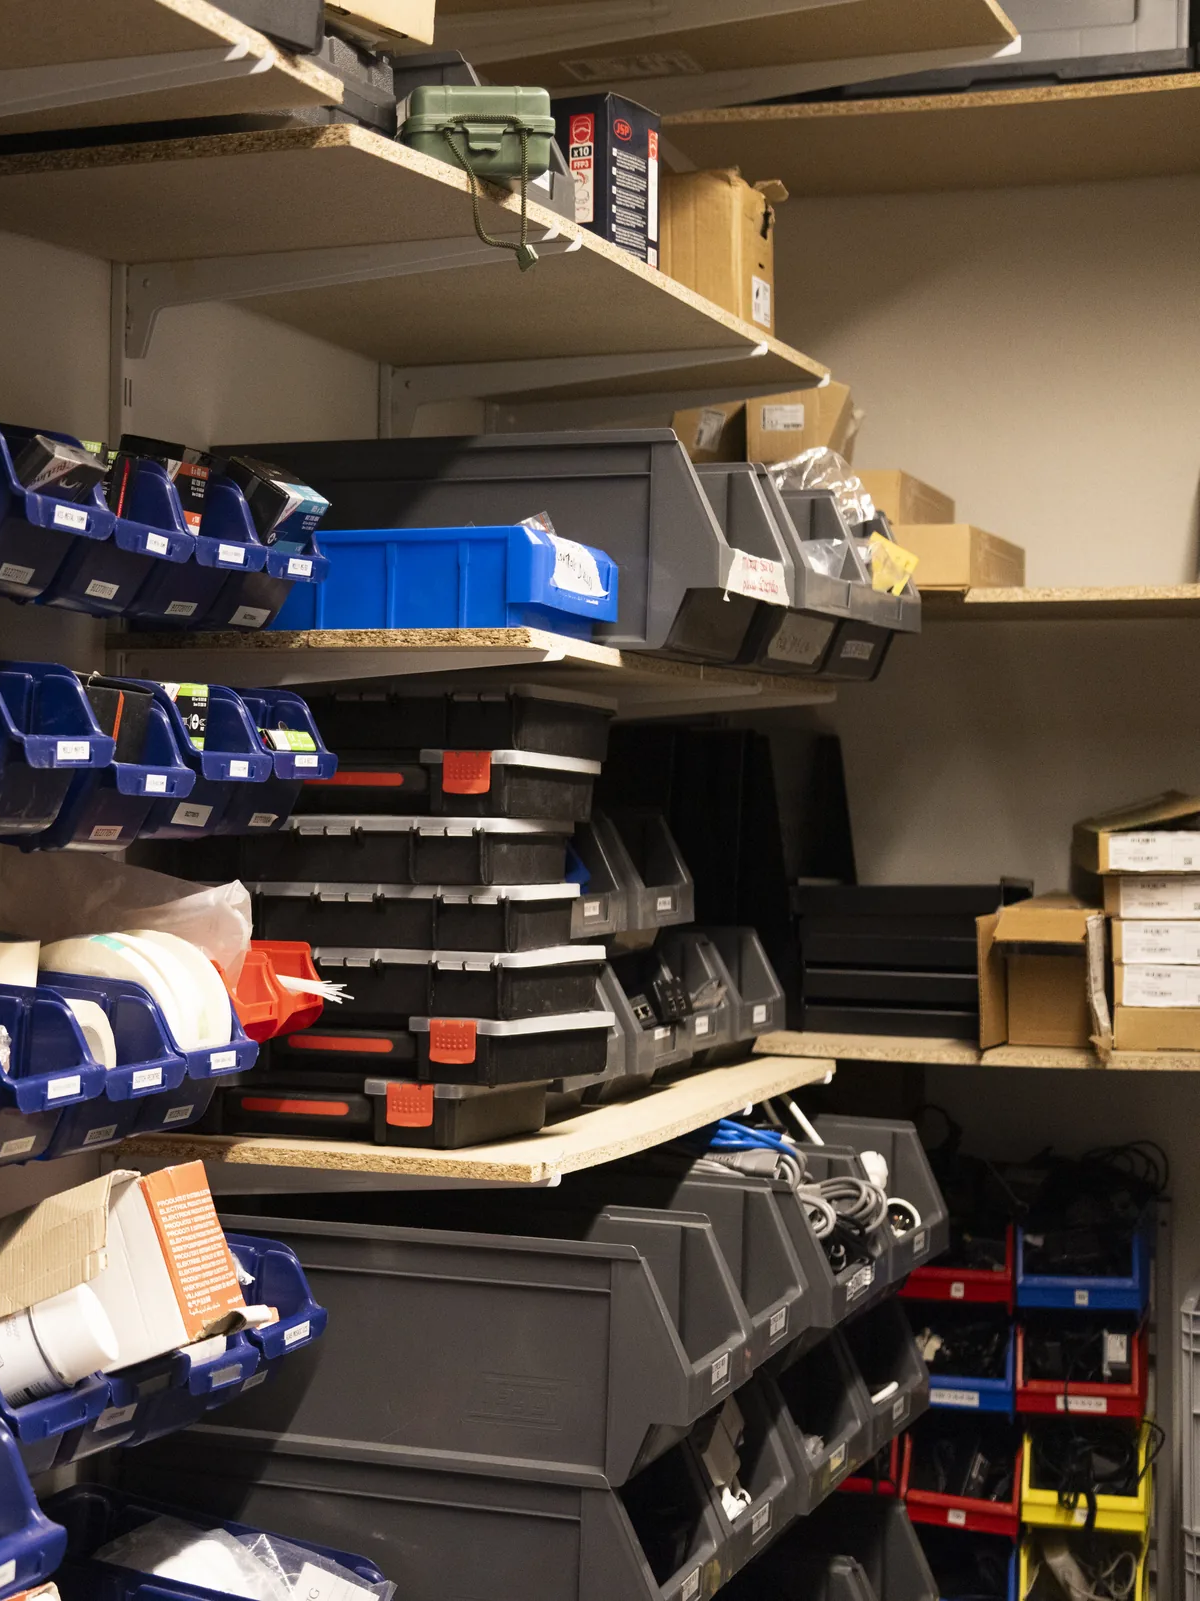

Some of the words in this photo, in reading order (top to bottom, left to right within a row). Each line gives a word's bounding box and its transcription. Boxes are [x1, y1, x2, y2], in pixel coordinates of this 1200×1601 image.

[616, 122, 630, 137] JSP
[573, 146, 590, 157] x10
[573, 160, 590, 169] FFP3
